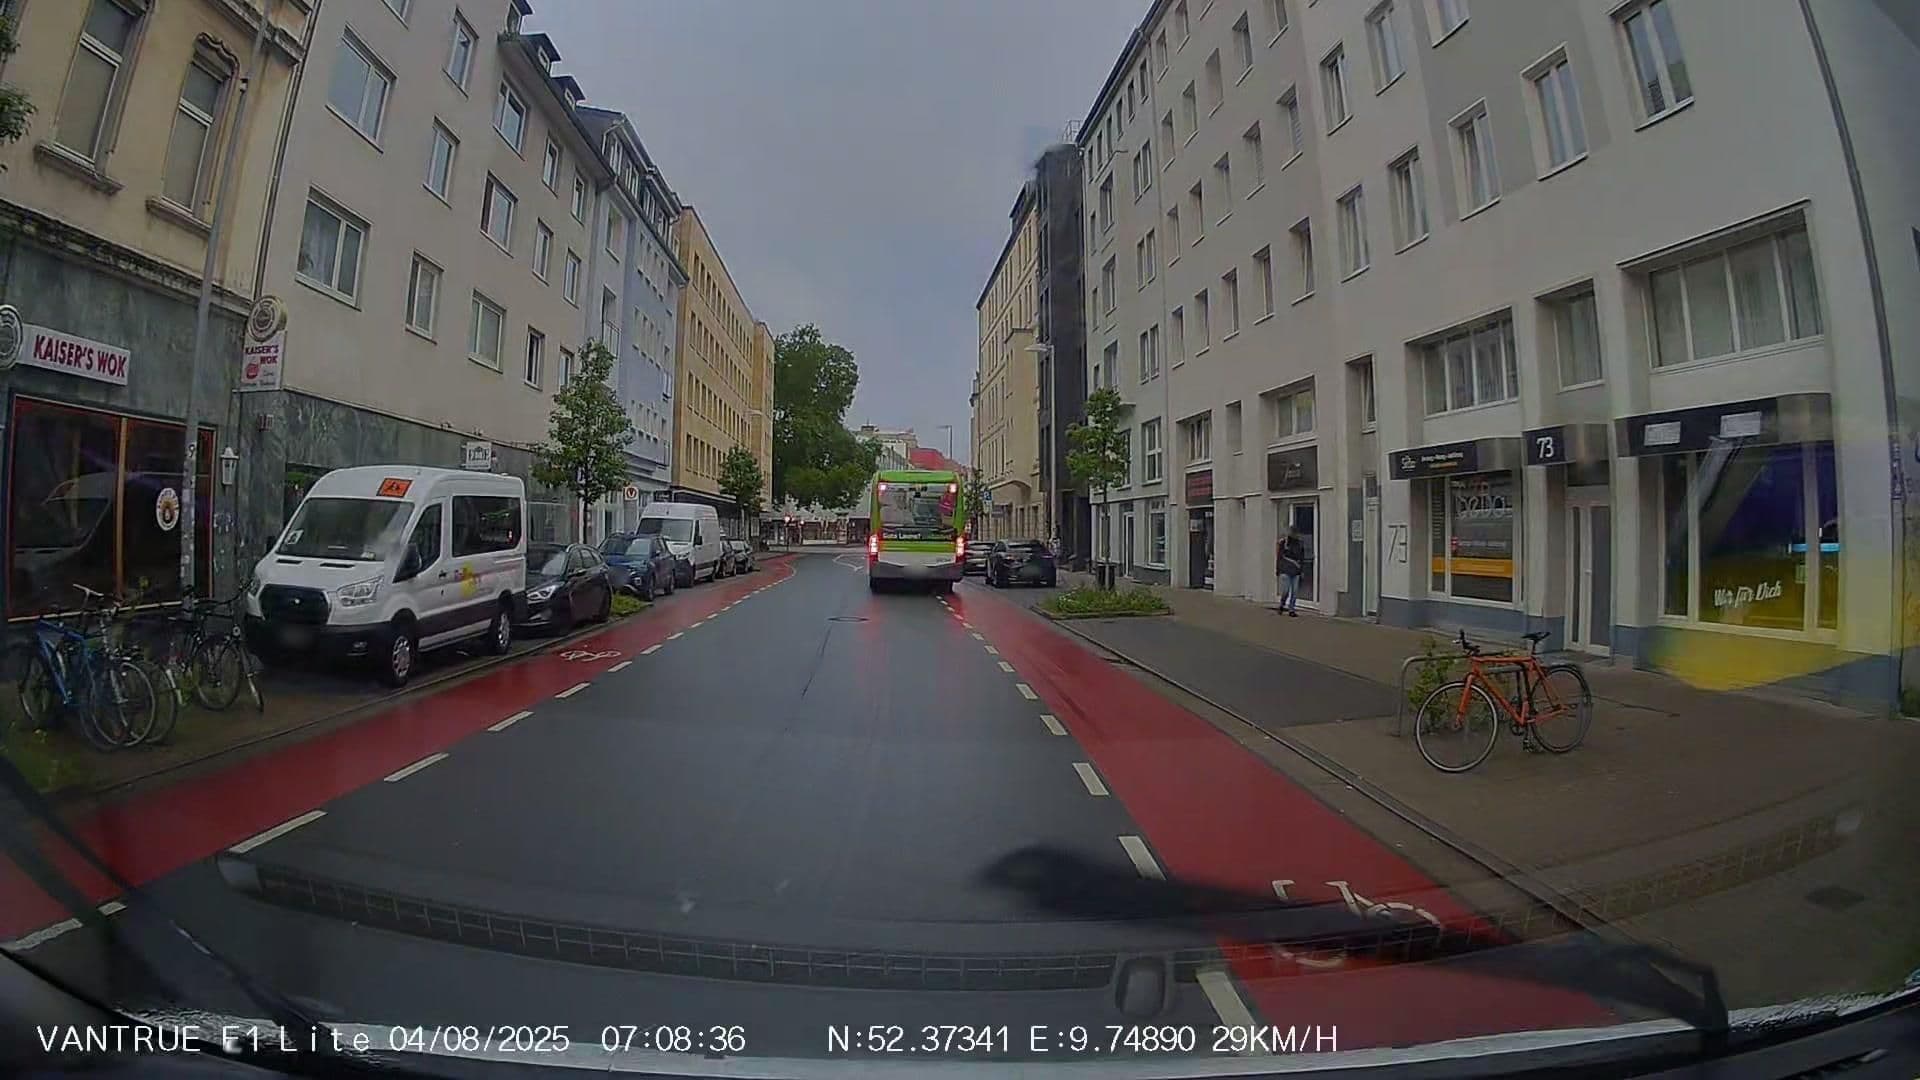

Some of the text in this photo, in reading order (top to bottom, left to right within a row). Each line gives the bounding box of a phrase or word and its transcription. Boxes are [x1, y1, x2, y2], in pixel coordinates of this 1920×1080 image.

[33, 334, 94, 371] KAISER'S
[97, 350, 127, 378] WOK
[244, 344, 279, 355] KAISER'S
[260, 355, 278, 365] WOK
[1536, 436, 1554, 459] 73
[1387, 524, 1408, 564] 73
[1755, 580, 1782, 601] Dich
